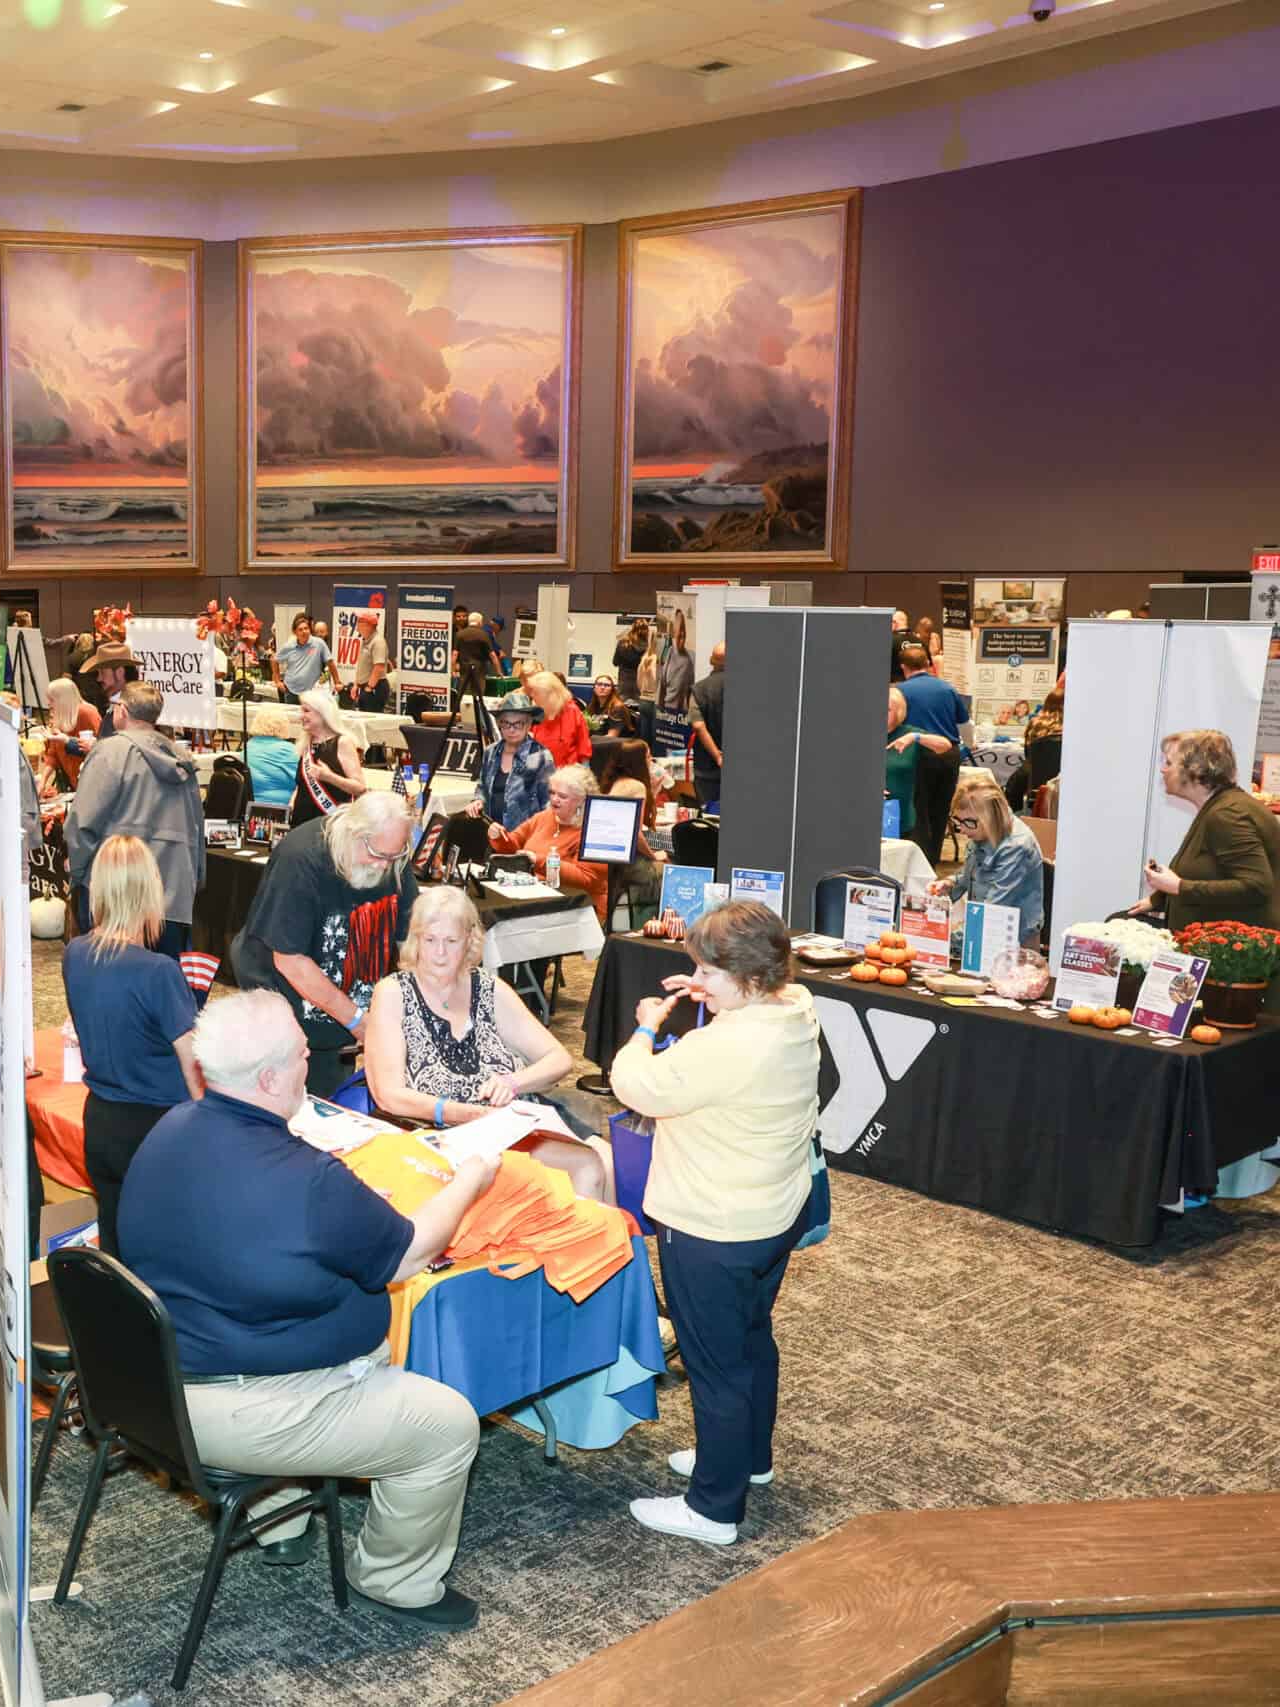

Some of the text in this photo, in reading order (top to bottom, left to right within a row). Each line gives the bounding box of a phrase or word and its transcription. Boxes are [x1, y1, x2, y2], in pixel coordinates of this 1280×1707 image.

[1258, 555, 1280, 570] EXIT
[401, 628, 449, 641] FREEDOM
[336, 637, 361, 665] WO
[403, 644, 447, 672] 96.9
[141, 672, 204, 695] omeCare
[30, 843, 57, 874] GY
[856, 1121, 888, 1157] YMCA
